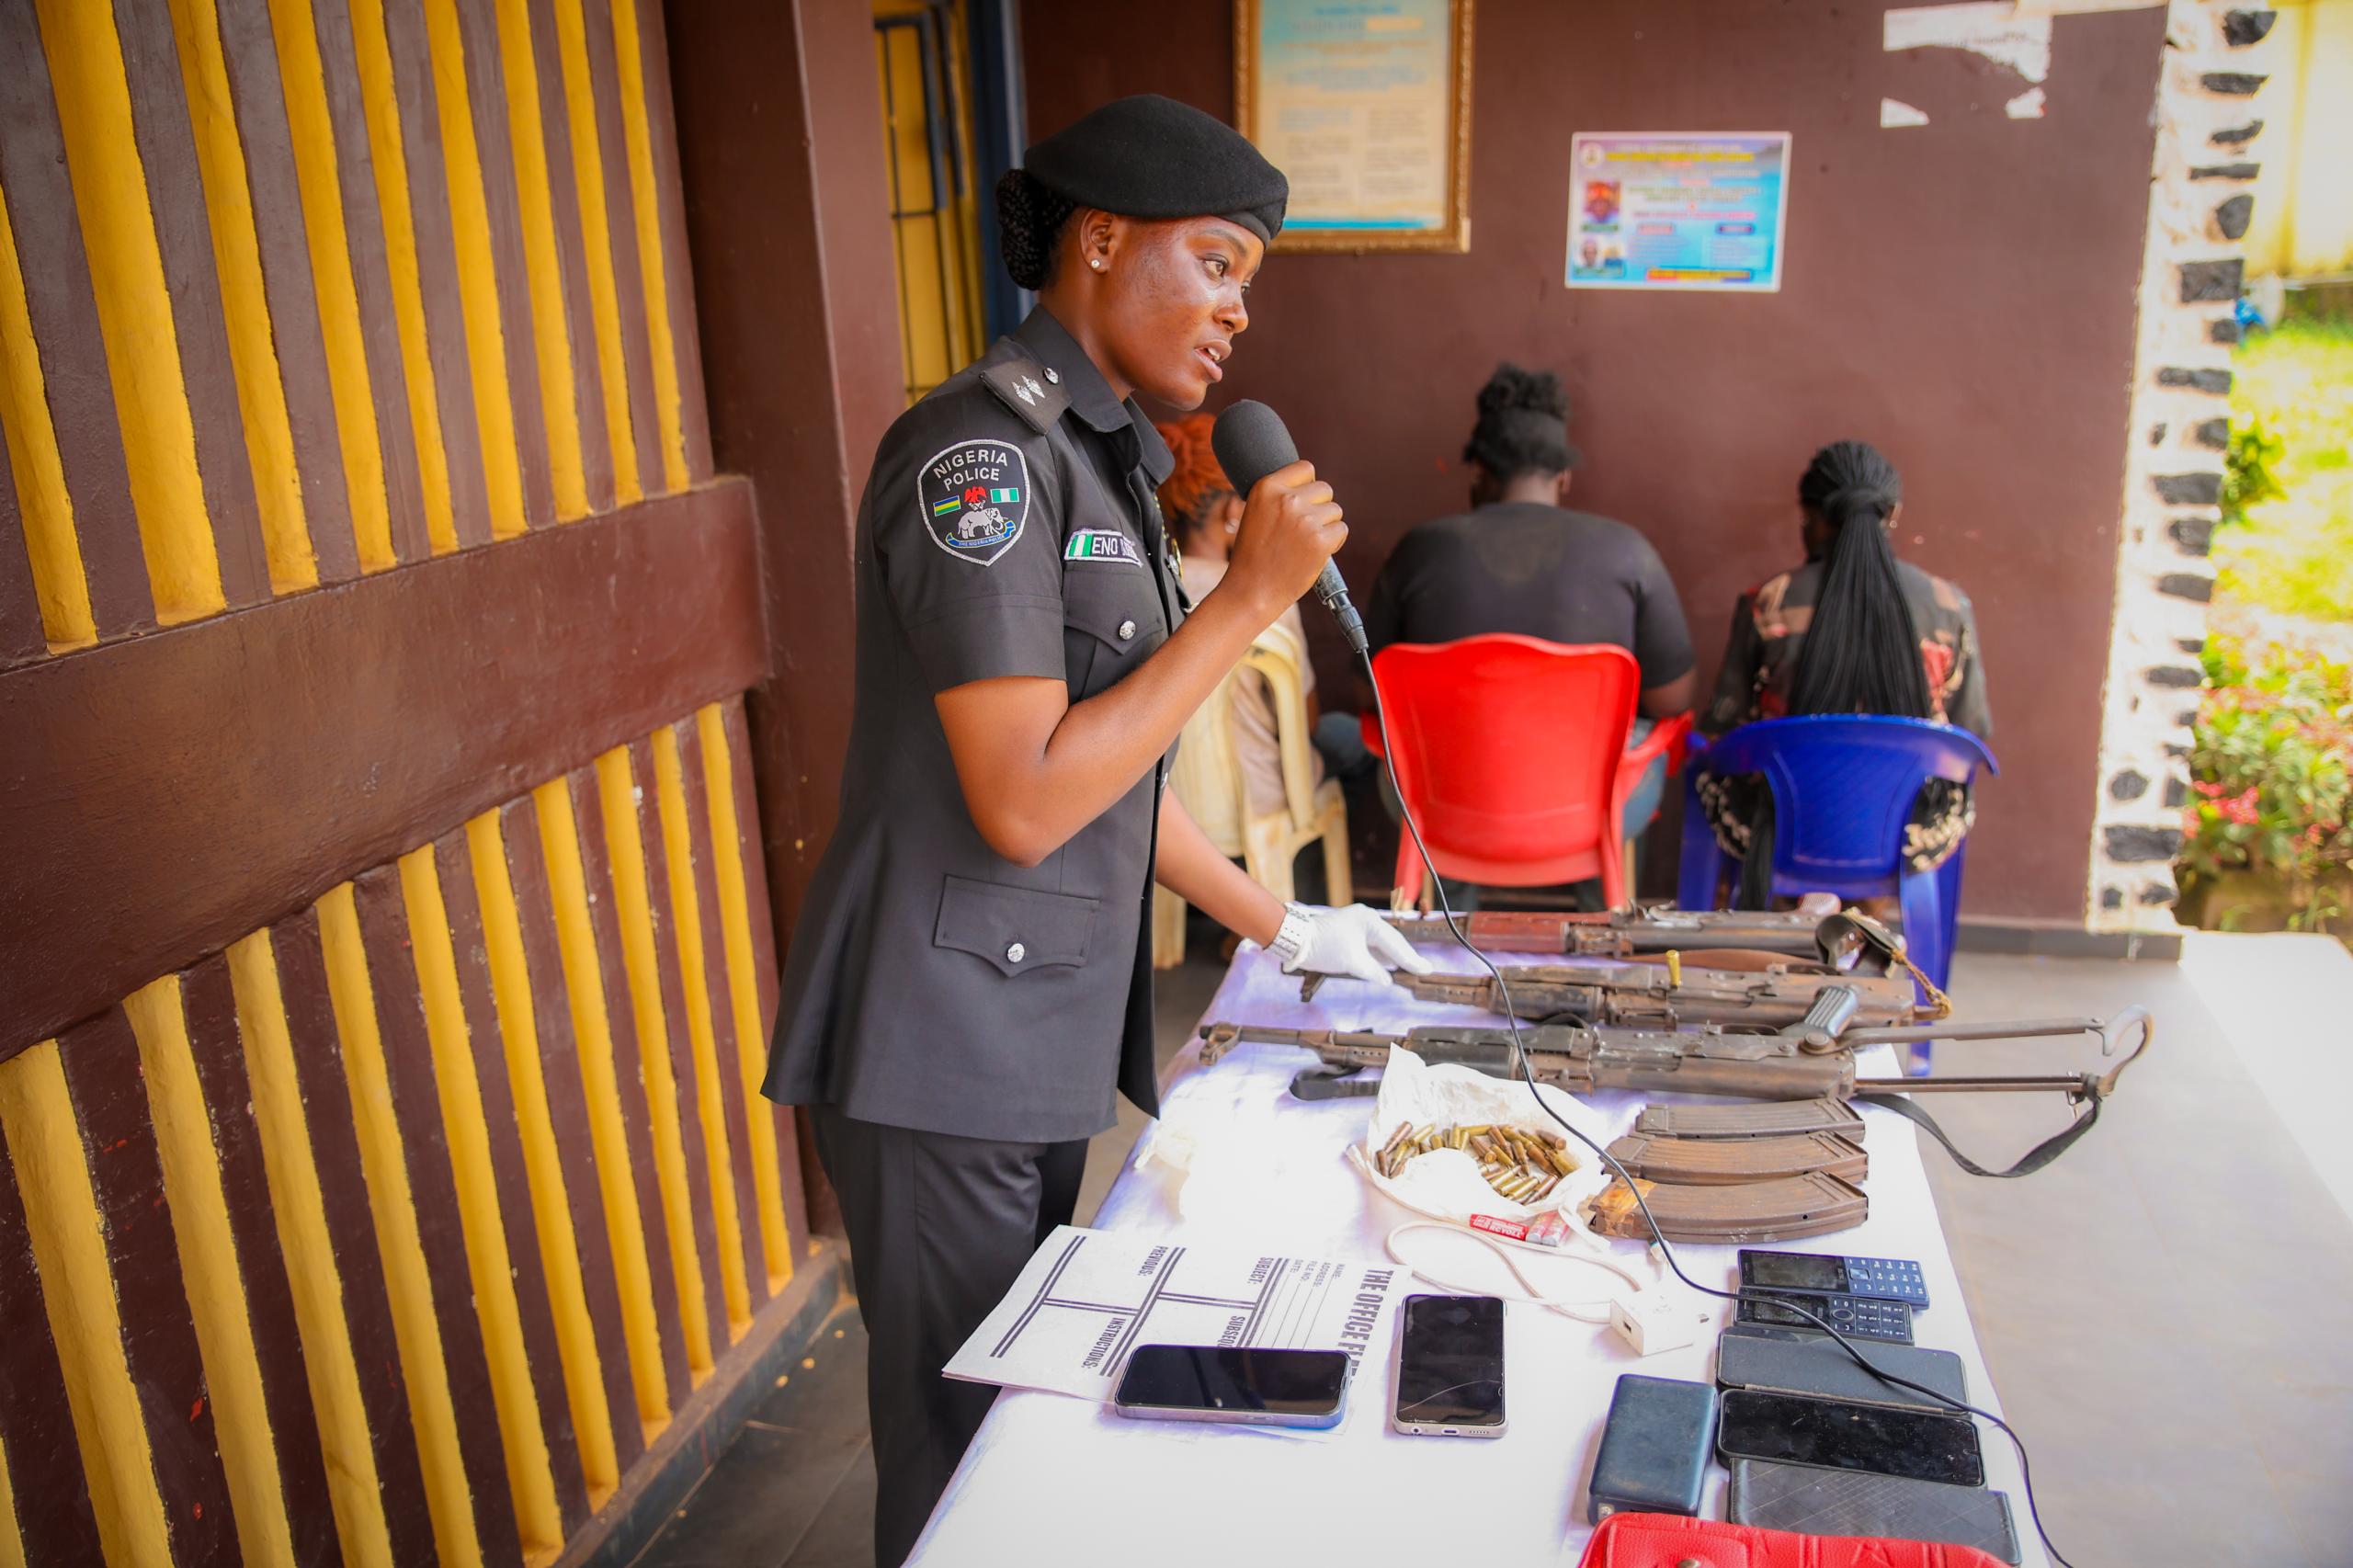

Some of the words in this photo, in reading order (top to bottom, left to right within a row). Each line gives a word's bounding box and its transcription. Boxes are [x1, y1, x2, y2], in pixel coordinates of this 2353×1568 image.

[933, 449, 1008, 479] NIGERIA
[943, 467, 1000, 492] POLICE
[1091, 536, 1119, 555] ENO
[1137, 1244, 1168, 1277] PREVIOUS:
[1247, 1256, 1275, 1284] SUBJECT:
[1359, 1269, 1395, 1291] THE
[1340, 1292, 1384, 1340] OFFICE
[1081, 1317, 1127, 1369] INSTRUCTIONS:
